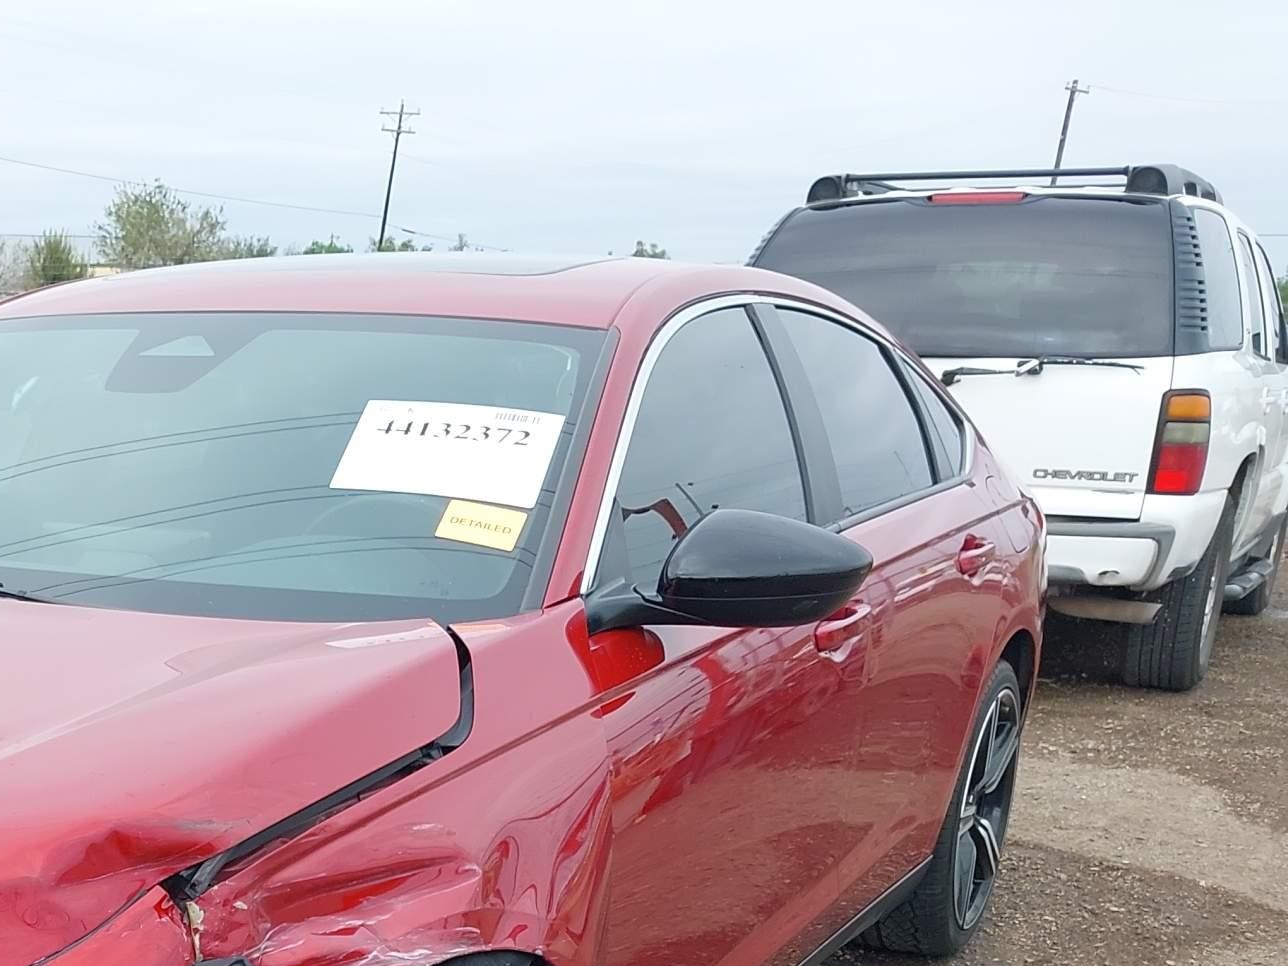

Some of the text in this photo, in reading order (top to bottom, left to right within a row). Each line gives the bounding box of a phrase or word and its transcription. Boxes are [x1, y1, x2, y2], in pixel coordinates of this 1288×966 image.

[376, 419, 531, 446] 44132372
[1032, 468, 1139, 483] CHEVROLET
[449, 516, 512, 535] DETAILED
